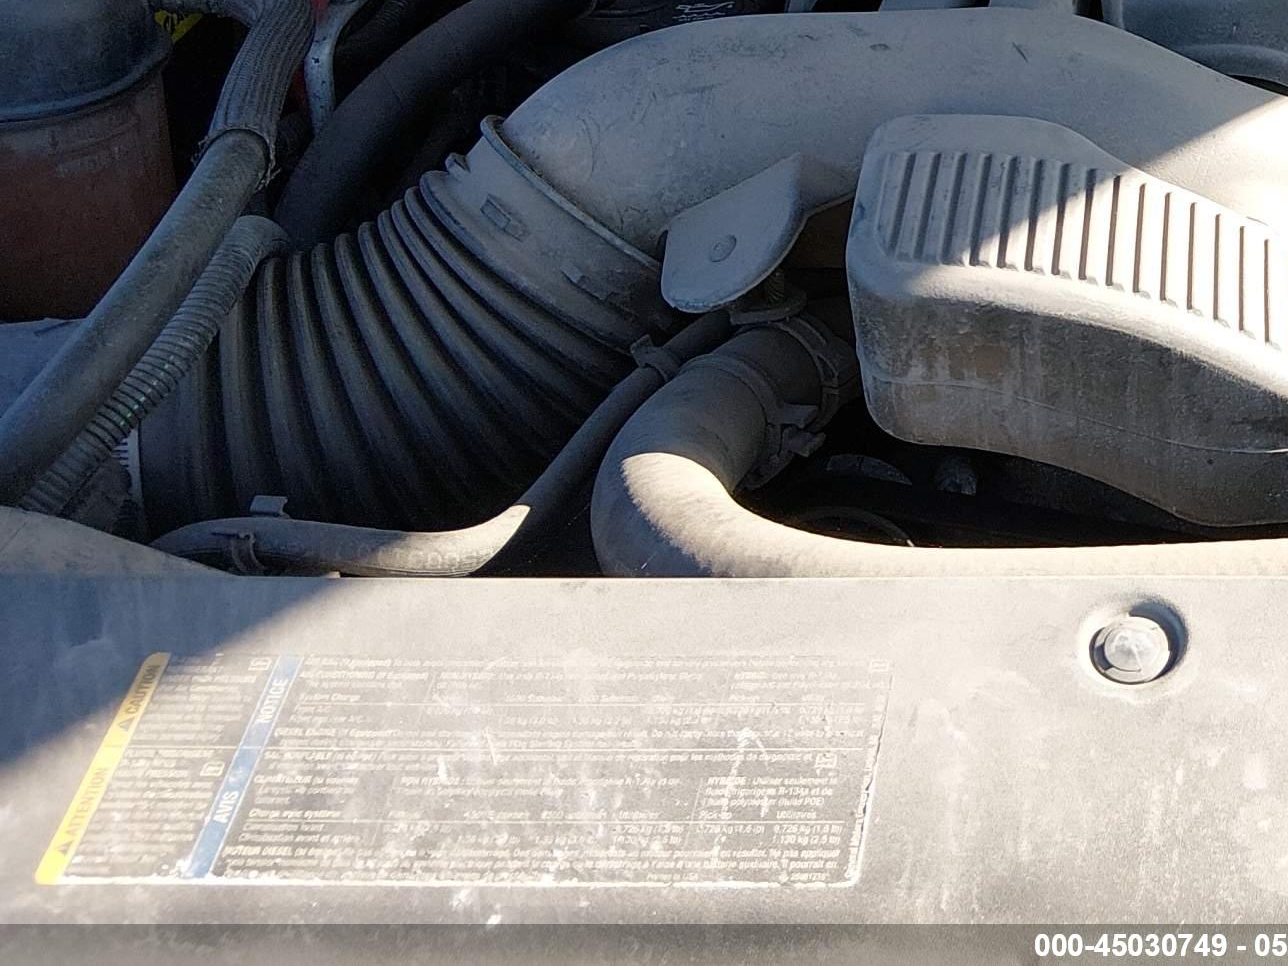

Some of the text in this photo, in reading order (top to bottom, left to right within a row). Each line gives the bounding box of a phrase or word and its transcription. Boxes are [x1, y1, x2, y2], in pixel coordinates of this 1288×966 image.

[125, 664, 161, 715] CAUTION
[255, 678, 288, 723] NOTICE
[65, 766, 109, 840] ATTENTION
[212, 790, 238, 823] AVIS
